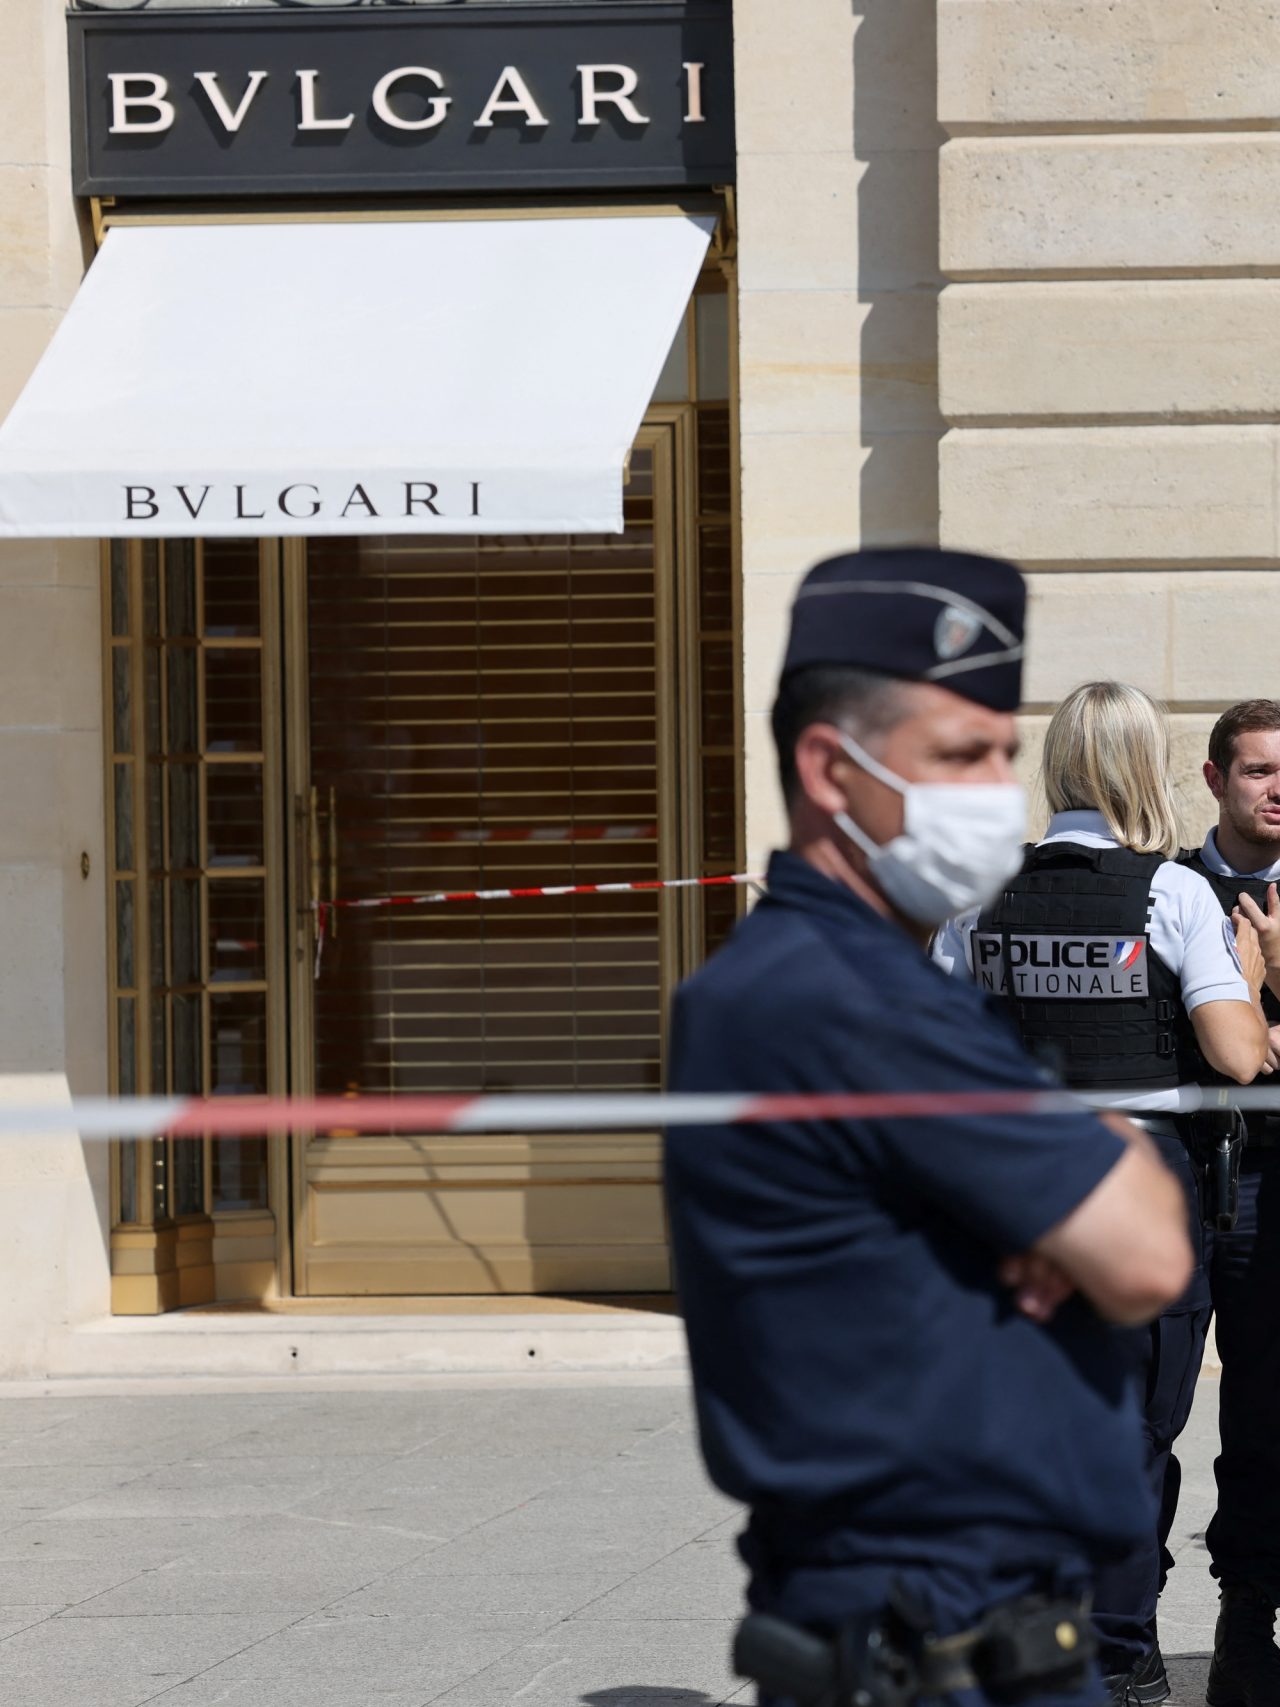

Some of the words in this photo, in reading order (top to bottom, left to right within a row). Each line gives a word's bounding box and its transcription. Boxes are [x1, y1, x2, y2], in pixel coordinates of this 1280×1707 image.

[107, 62, 705, 134] BVLGARI
[122, 482, 483, 520] BVLGARI
[979, 939, 1109, 968] POLICE
